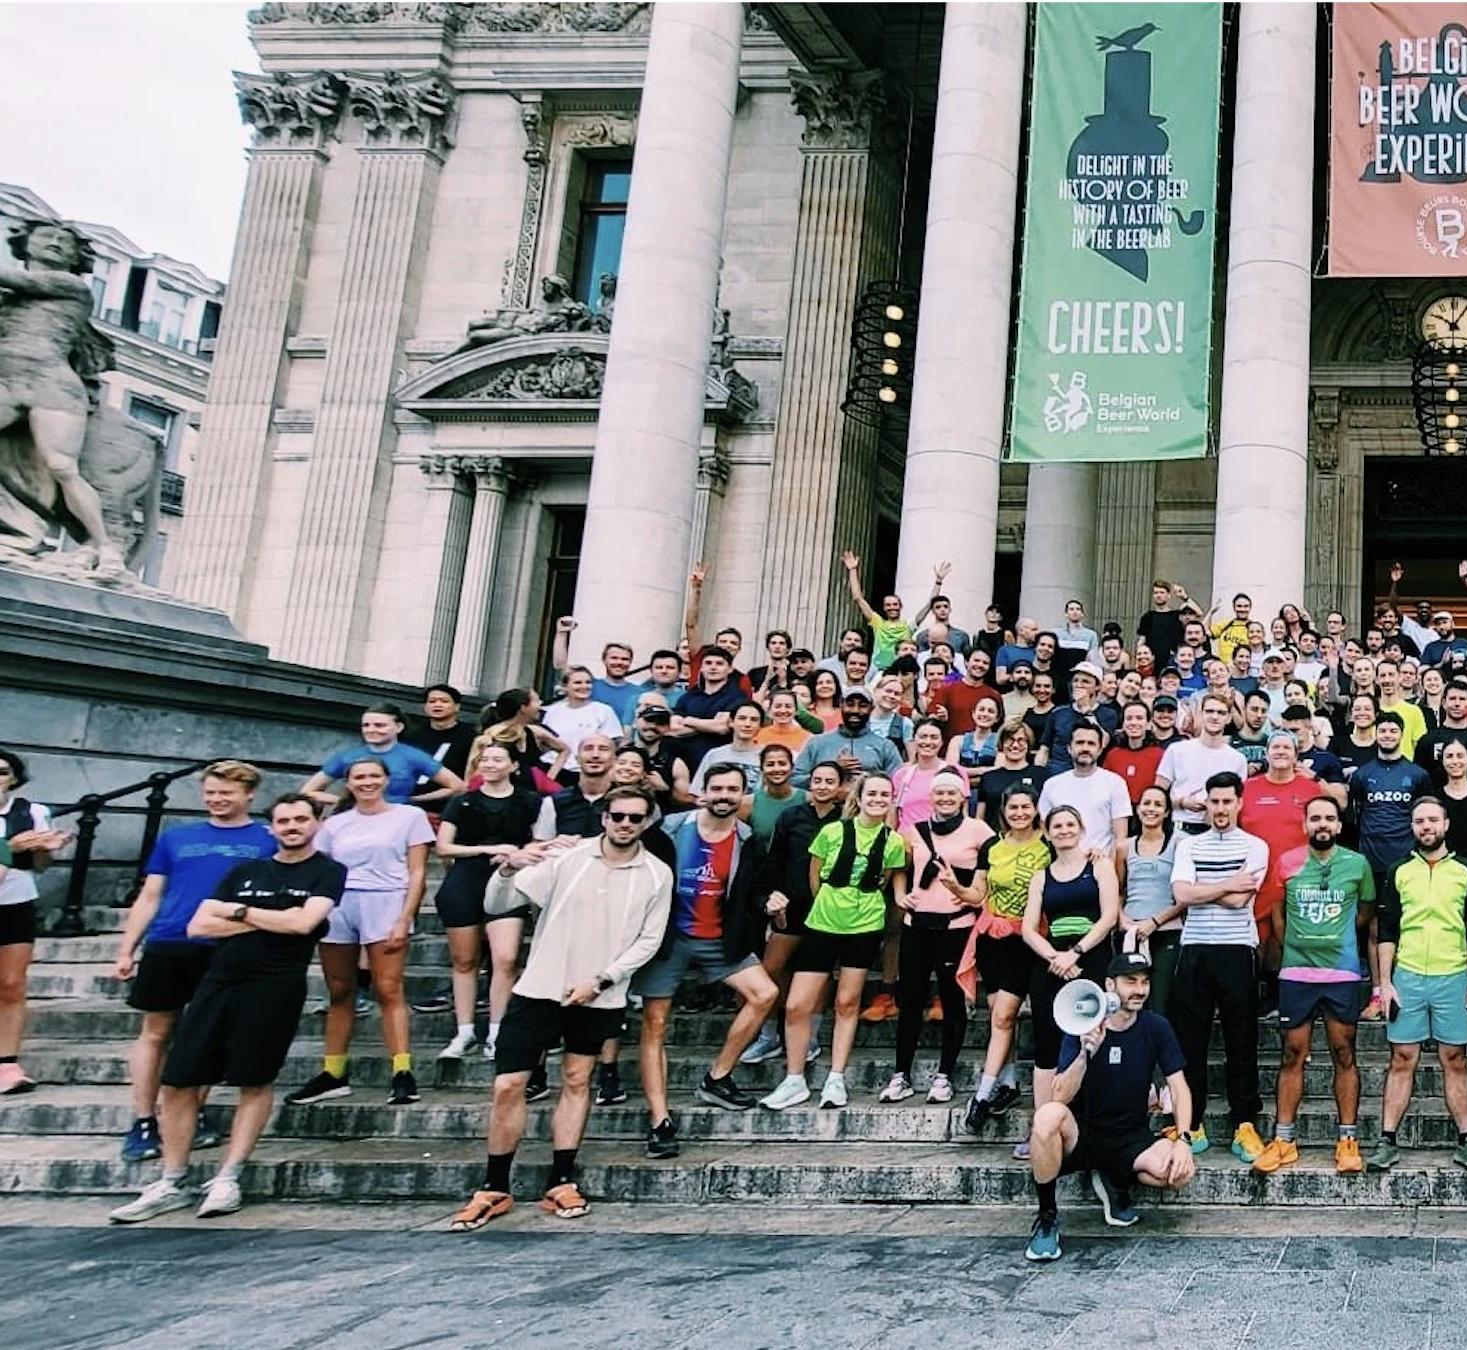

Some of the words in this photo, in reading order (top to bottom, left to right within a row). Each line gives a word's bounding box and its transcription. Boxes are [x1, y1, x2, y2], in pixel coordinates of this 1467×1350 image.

[1359, 83, 1420, 126] BEER
[1149, 155, 1173, 176] THE
[1126, 179, 1154, 200] OF
[1158, 179, 1188, 200] BEER
[1109, 204, 1118, 225] A
[1091, 228, 1113, 250] THE
[1116, 227, 1171, 250] BEERLAB
[1048, 301, 1185, 354] CHEERS!
[1098, 392, 1157, 409] Belgian
[1097, 407, 1135, 421] Beer
[1137, 405, 1181, 421] World
